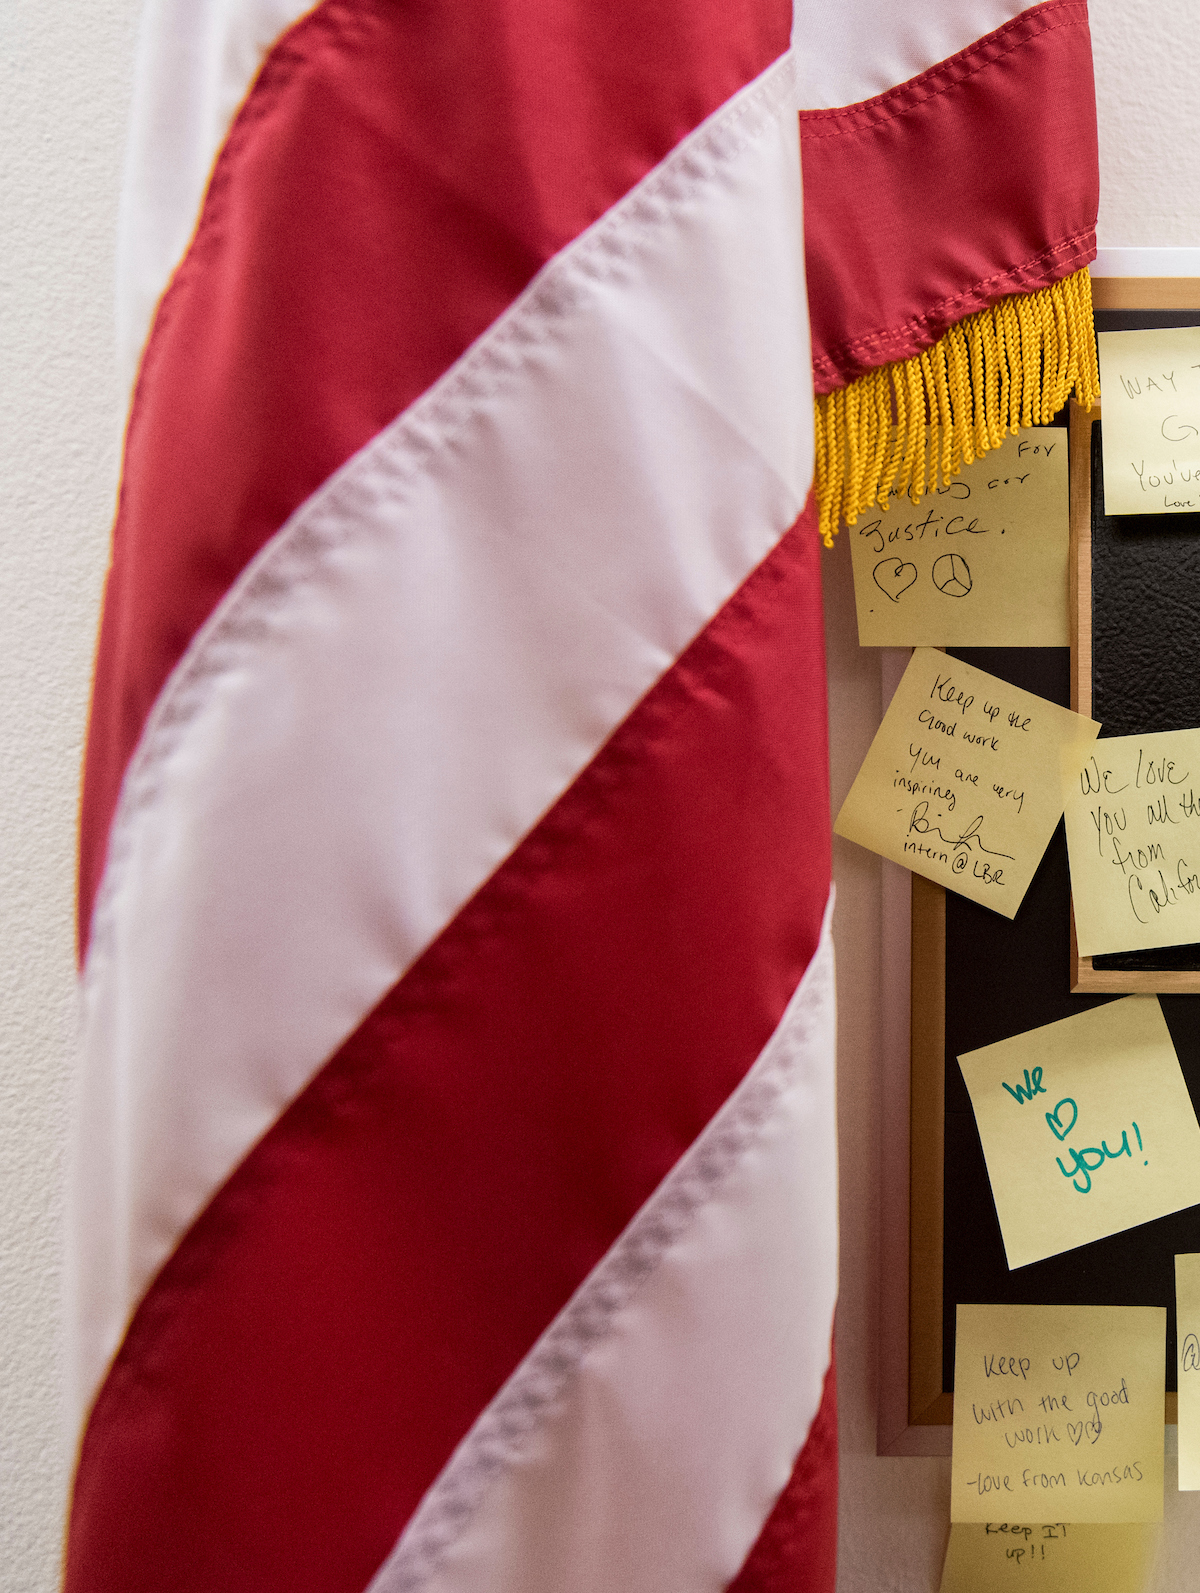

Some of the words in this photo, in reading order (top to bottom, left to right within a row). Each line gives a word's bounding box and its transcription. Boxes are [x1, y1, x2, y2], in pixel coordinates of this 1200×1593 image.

[1120, 371, 1177, 399] WAY
[1131, 459, 1200, 491] You've
[930, 674, 974, 714] Keep
[984, 700, 1000, 722] up
[1008, 711, 1031, 732] the
[963, 730, 1001, 752] work
[1080, 755, 1130, 796] We
[1135, 749, 1190, 789] love
[955, 769, 979, 787] are
[993, 783, 1025, 814] very
[1147, 795, 1180, 825] all
[1056, 1121, 1149, 1194] you!
[1052, 1352, 1081, 1376] up
[972, 1397, 1024, 1425] with
[1038, 1394, 1074, 1414] the
[1086, 1378, 1130, 1425] good
[1005, 1425, 1061, 1449] work
[1022, 1468, 1067, 1489] from
